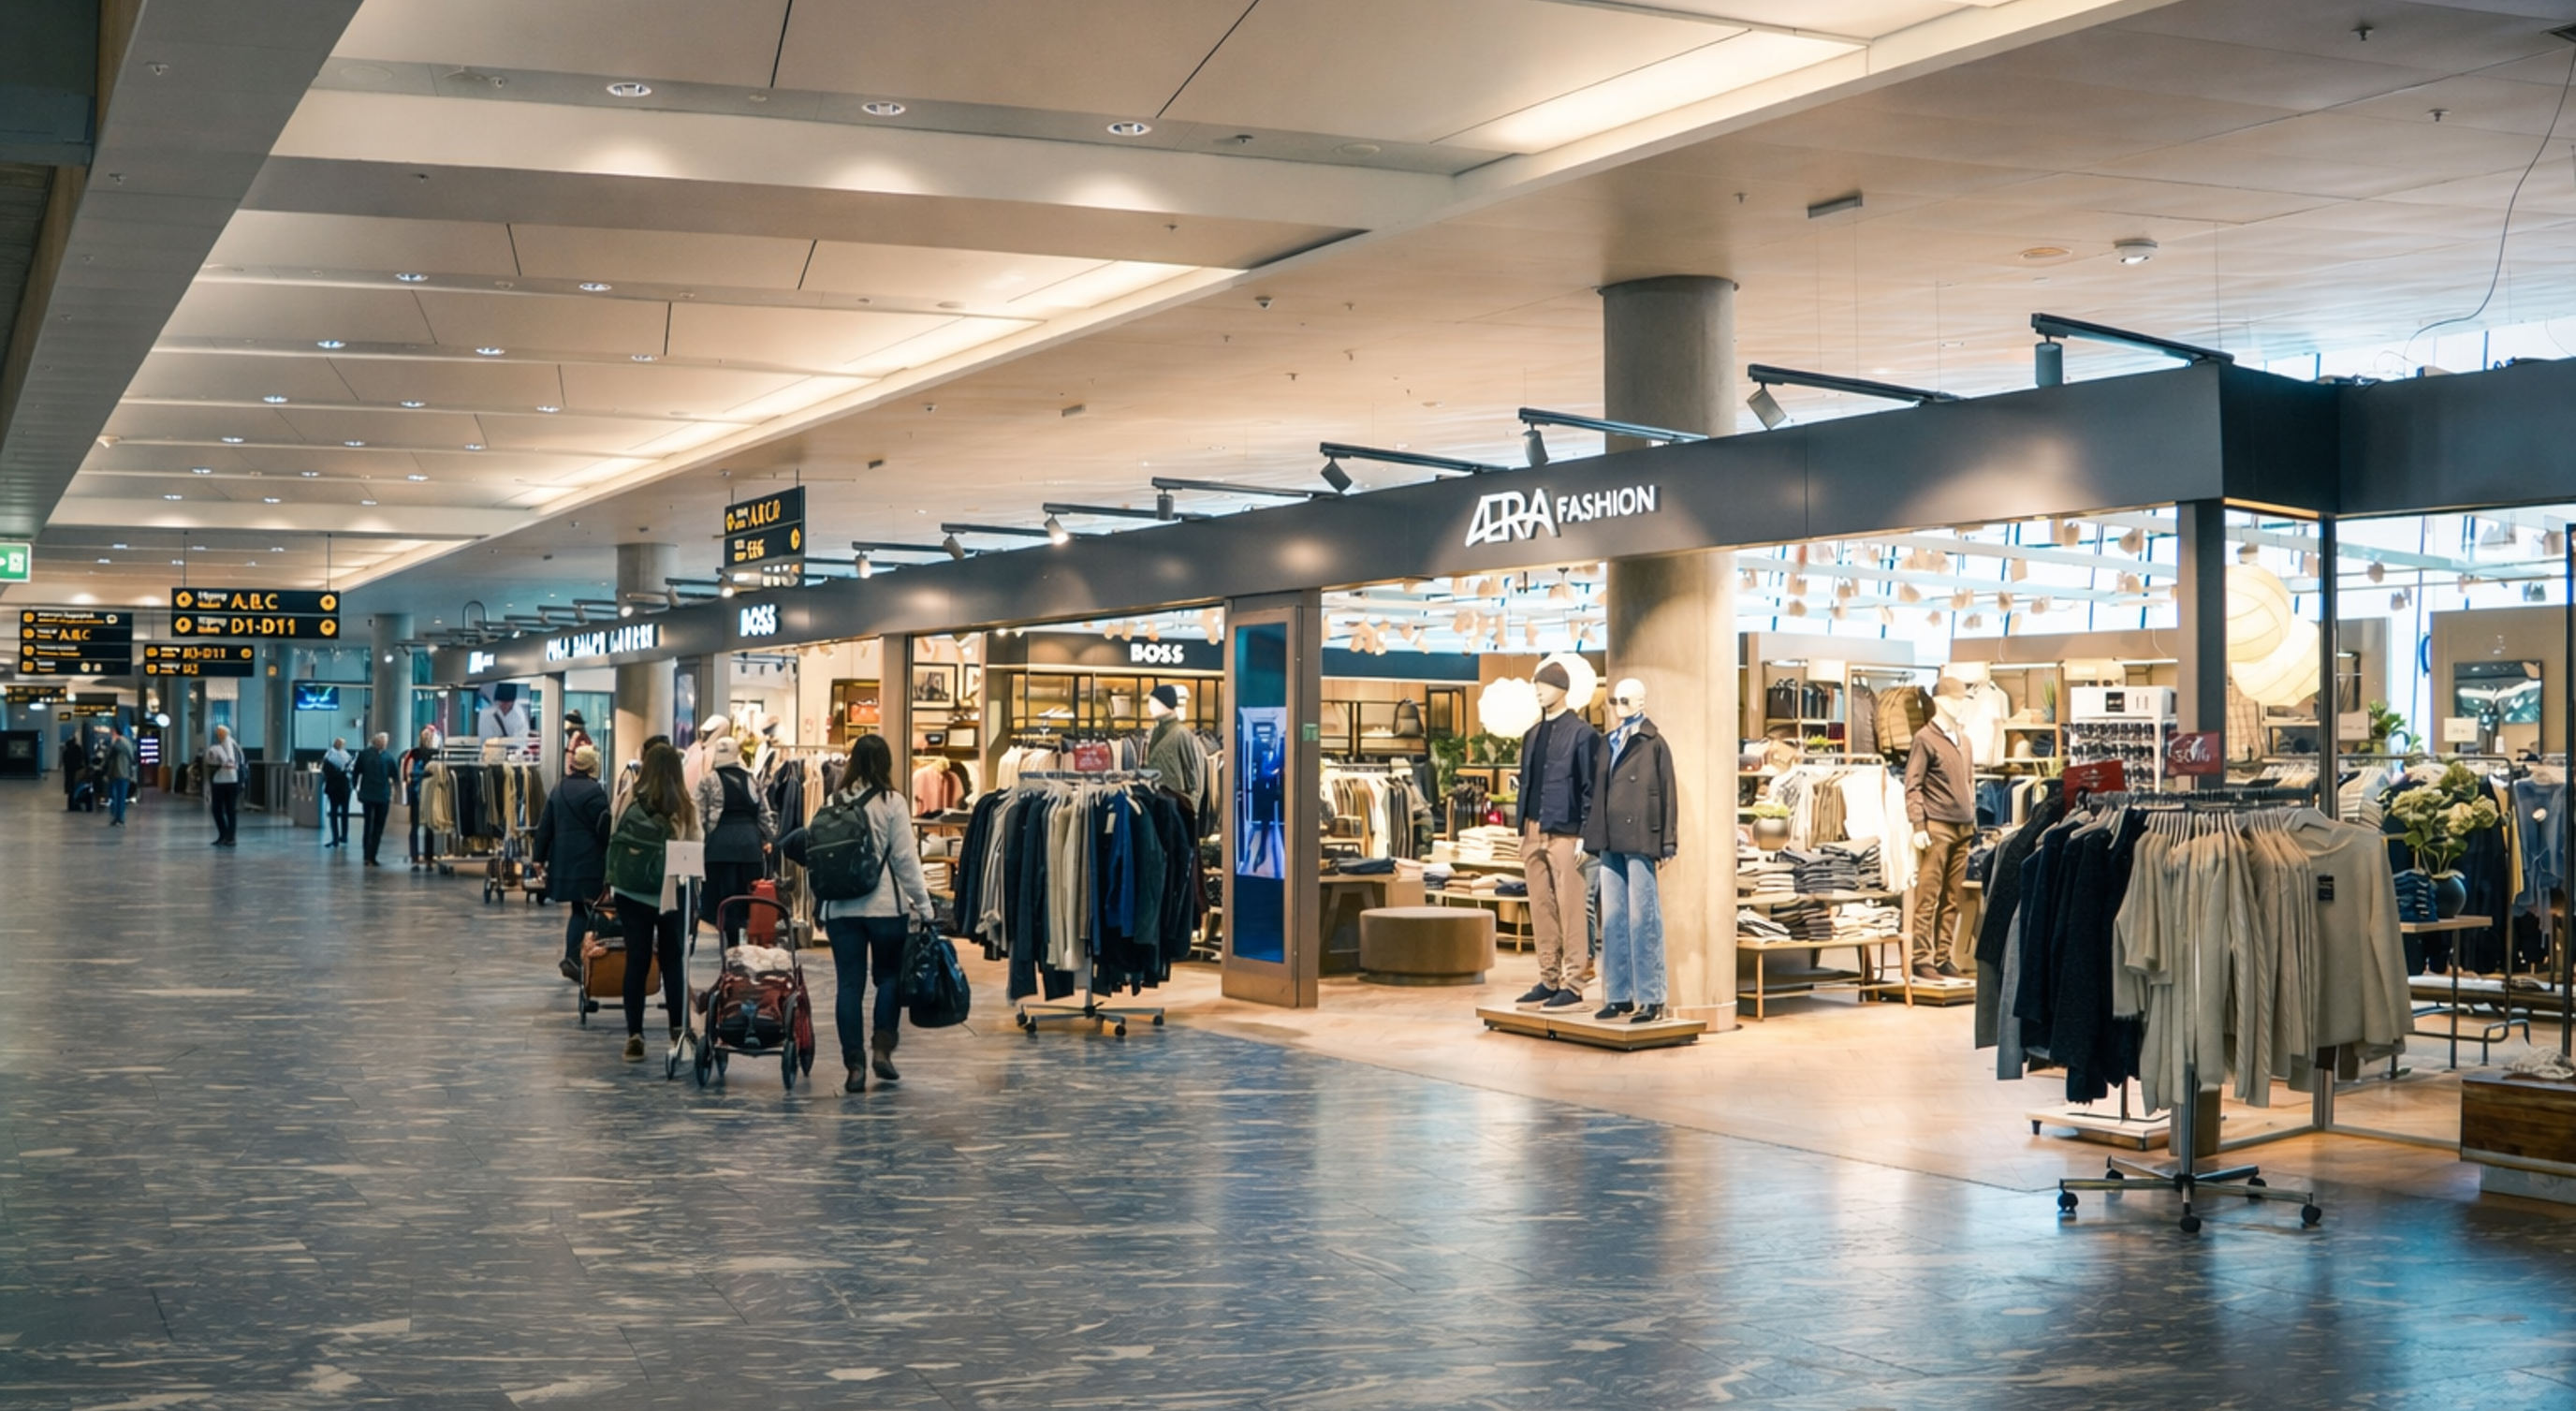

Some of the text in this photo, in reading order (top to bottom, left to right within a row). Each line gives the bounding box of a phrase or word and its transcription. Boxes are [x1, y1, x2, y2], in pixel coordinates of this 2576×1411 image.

[1557, 484, 1655, 523] FASHION
[230, 618, 296, 636] D1-D11
[740, 603, 776, 637] BOSS
[1131, 643, 1184, 664] BOSS
